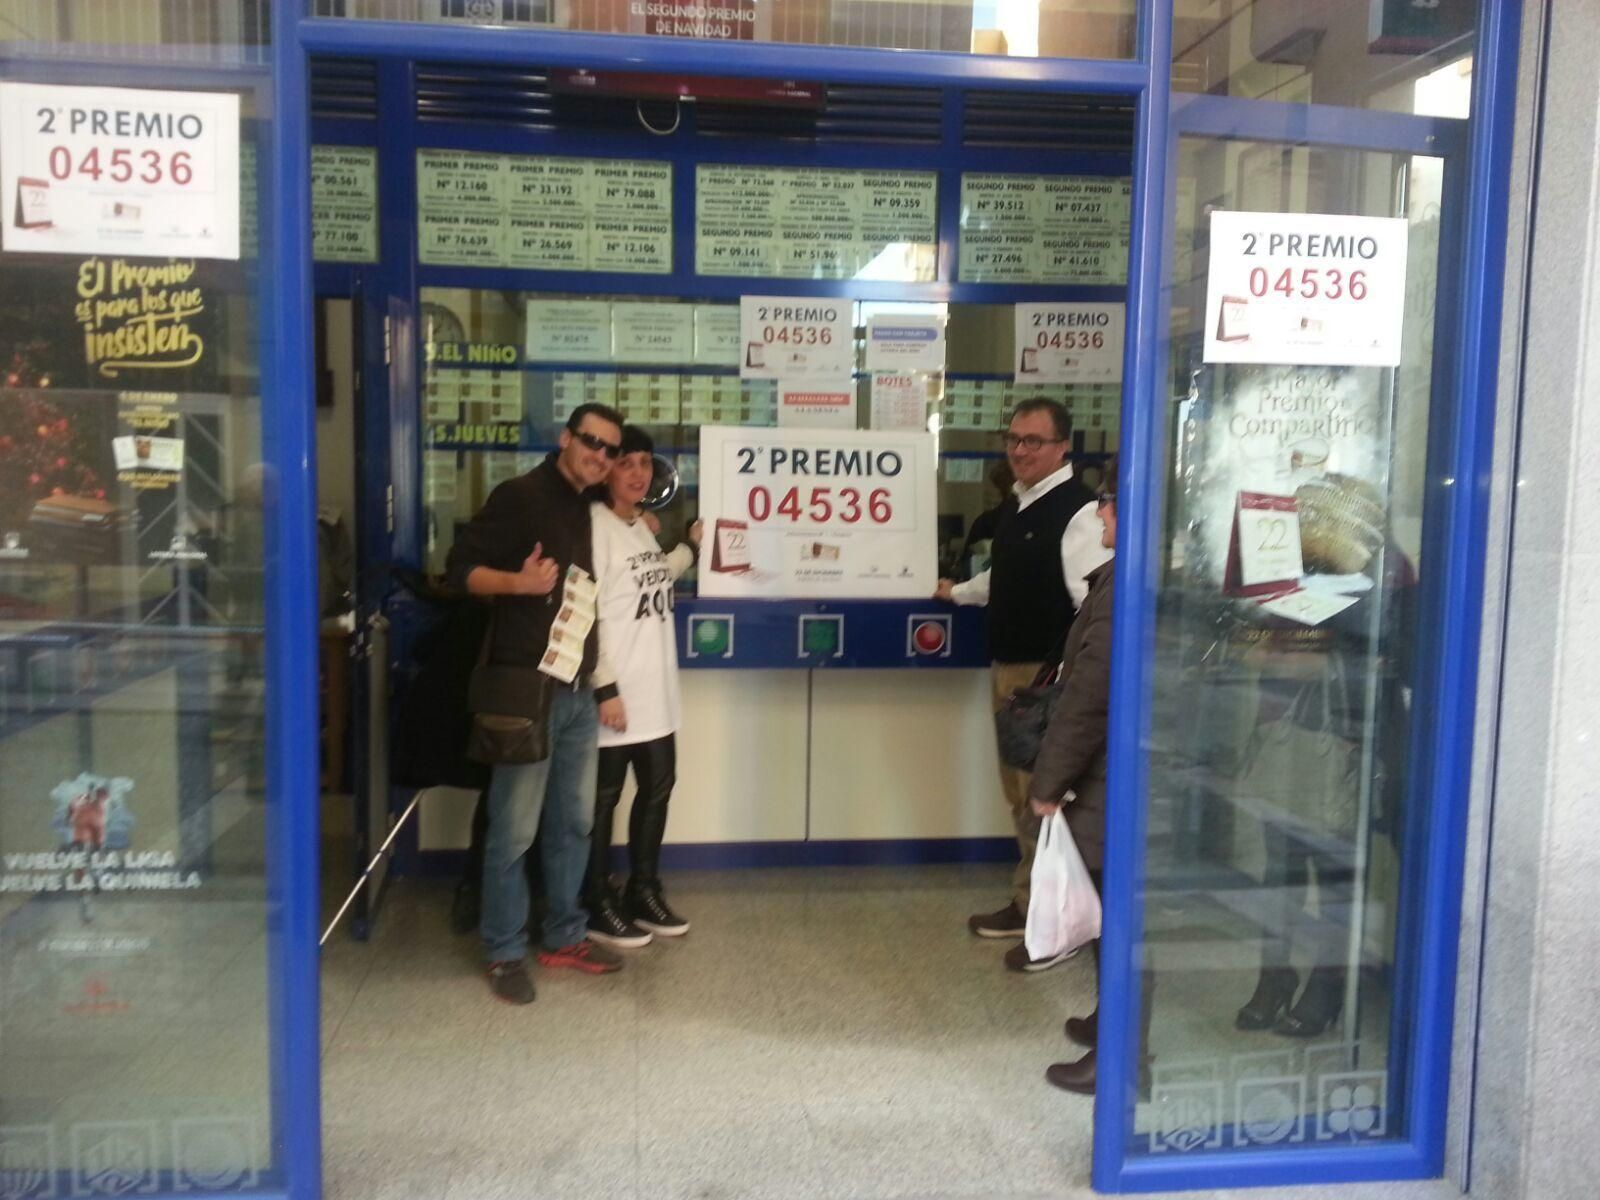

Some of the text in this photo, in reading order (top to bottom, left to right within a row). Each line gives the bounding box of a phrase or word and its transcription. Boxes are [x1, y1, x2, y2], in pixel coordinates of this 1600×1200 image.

[631, 2, 756, 22] EL SEGUNDO PREMIO
[656, 20, 731, 37] DE NAVIDAD
[70, 108, 203, 140] PREMIO
[49, 145, 193, 185] 04536
[424, 160, 499, 172] PRIMER PREMIO
[510, 165, 584, 176] PRIMER PREMIO
[595, 168, 667, 179] PRIMER PREMIO
[863, 179, 932, 190] SEGUNDO PREMIO
[967, 183, 1035, 192] SEGUNDO PREMIO
[1045, 184, 1082, 193] SEGUNDO
[1085, 185, 1112, 194] PREMIO
[425, 216, 500, 227] PRIMER PREMIO
[511, 220, 584, 231] PRIMER PREMIO
[595, 223, 667, 234] PRIMER PREMIO
[702, 228, 773, 239] SEGUNDO PREMIO
[783, 231, 853, 241] SEGUNDO PREMIO
[1043, 240, 1111, 250] SEGUNDO PREMIO
[1269, 233, 1379, 260] PREMIO
[75, 256, 196, 298] El Premio
[1249, 266, 1368, 301] 04536
[96, 296, 140, 328] para
[142, 288, 165, 313] los
[170, 288, 203, 322] que
[773, 308, 838, 323] PREMIO
[1047, 312, 1109, 327] PREMIO
[85, 311, 203, 366] insisten
[763, 325, 833, 345] 04536
[1037, 330, 1104, 350] 04536
[468, 343, 517, 365] NIÑO
[876, 375, 912, 388] BOTES
[770, 447, 903, 478] PREMIO
[748, 485, 893, 524] 04536
[1257, 518, 1289, 552] 22
[91, 851, 122, 869] LA
[65, 873, 96, 891] LA
